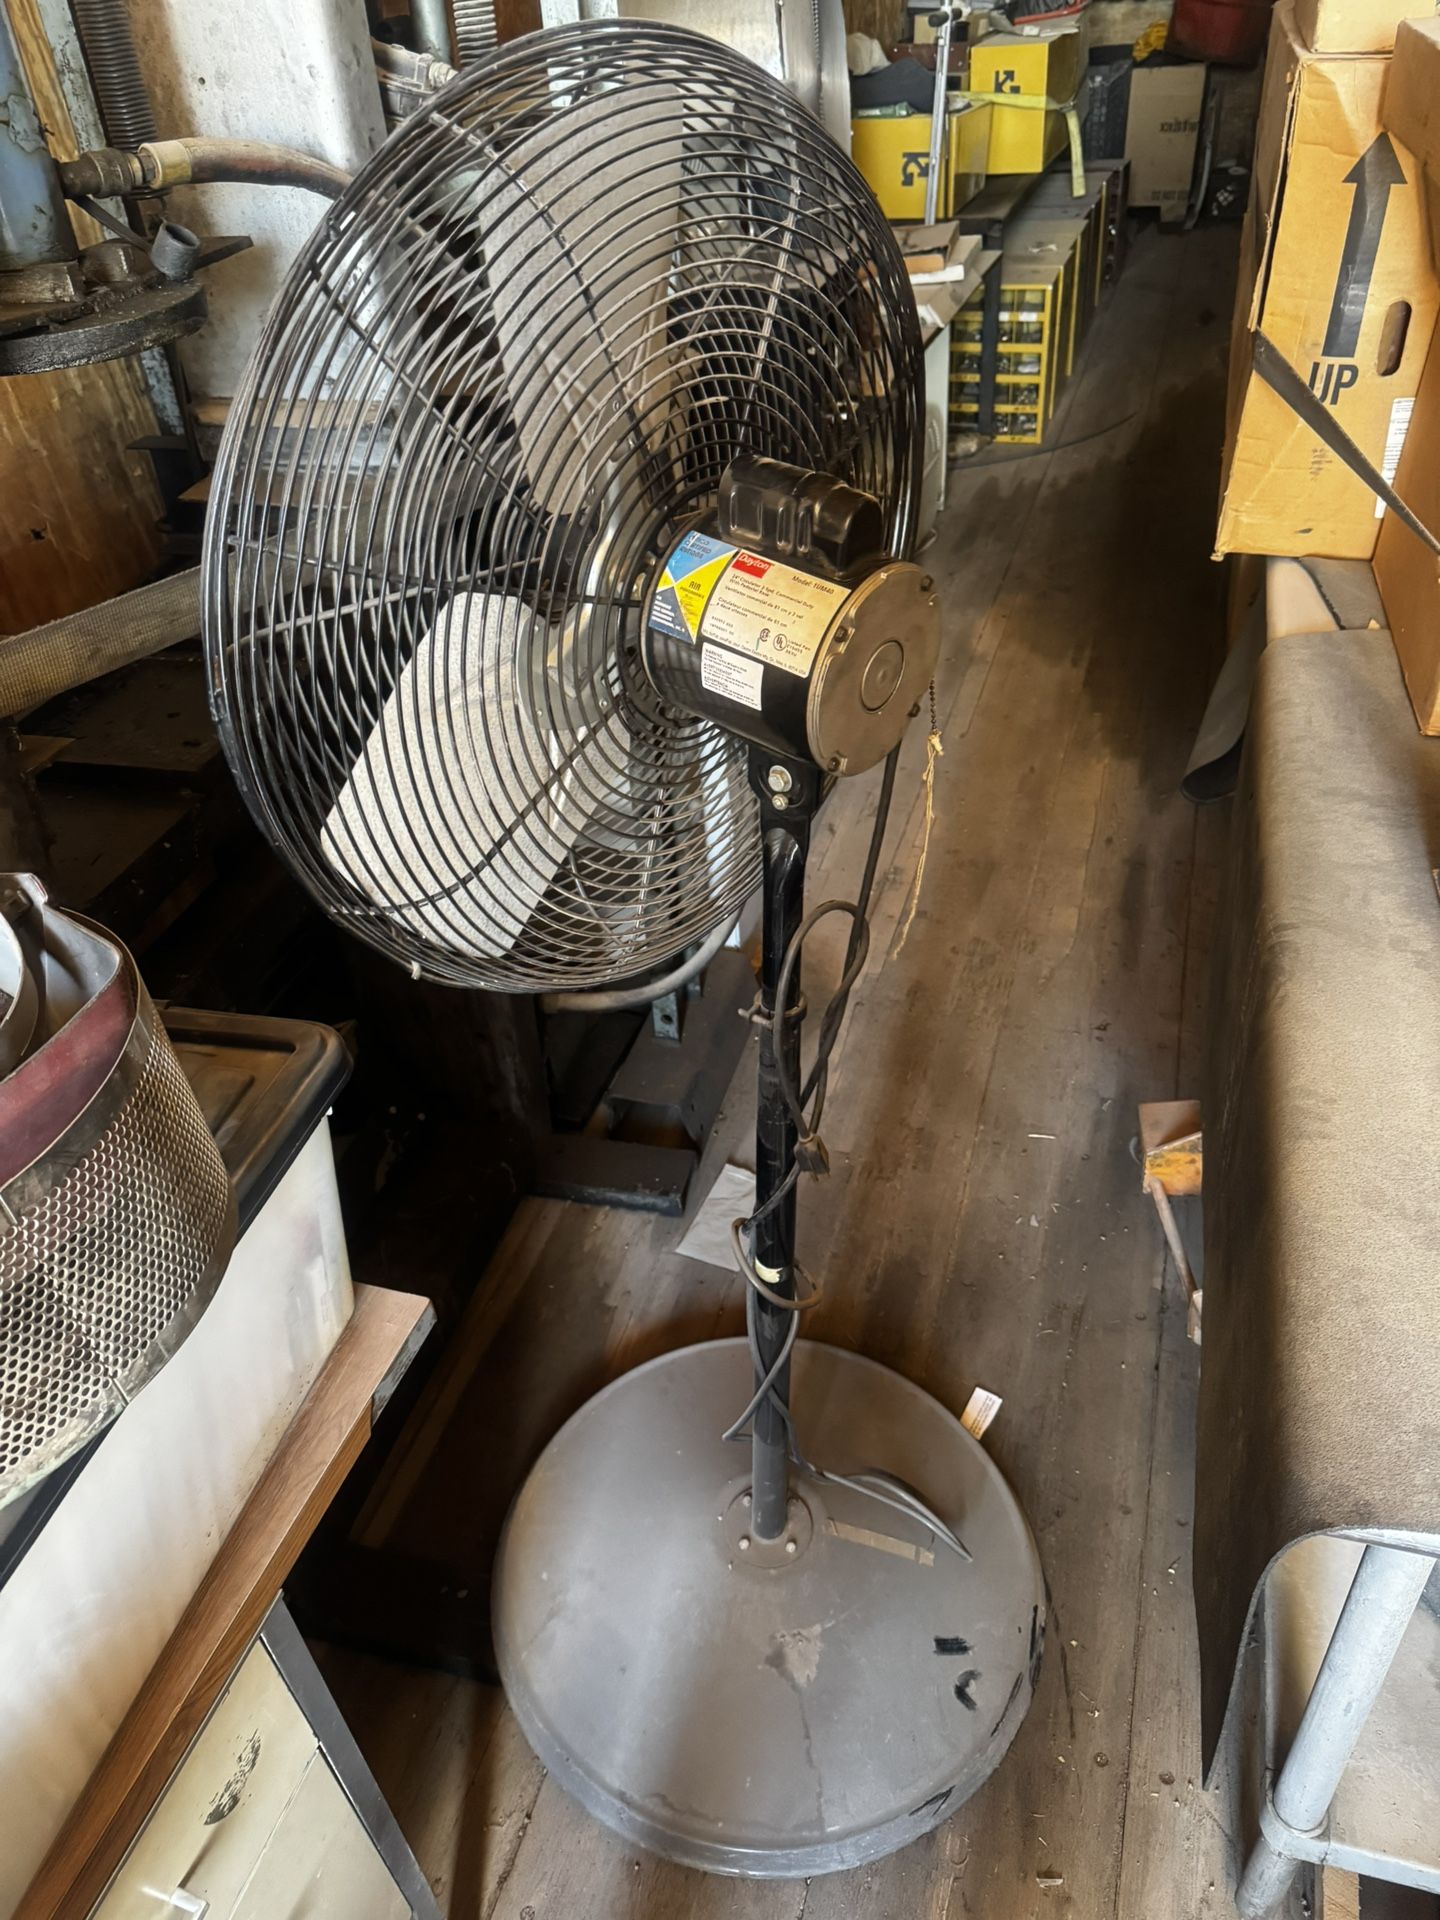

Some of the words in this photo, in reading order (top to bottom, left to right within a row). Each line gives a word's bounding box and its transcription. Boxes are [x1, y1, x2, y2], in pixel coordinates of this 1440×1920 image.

[1307, 362, 1358, 406] UP
[738, 552, 769, 571] Dayton
[688, 581, 701, 590] AIR
[801, 601, 814, 610] Duty
